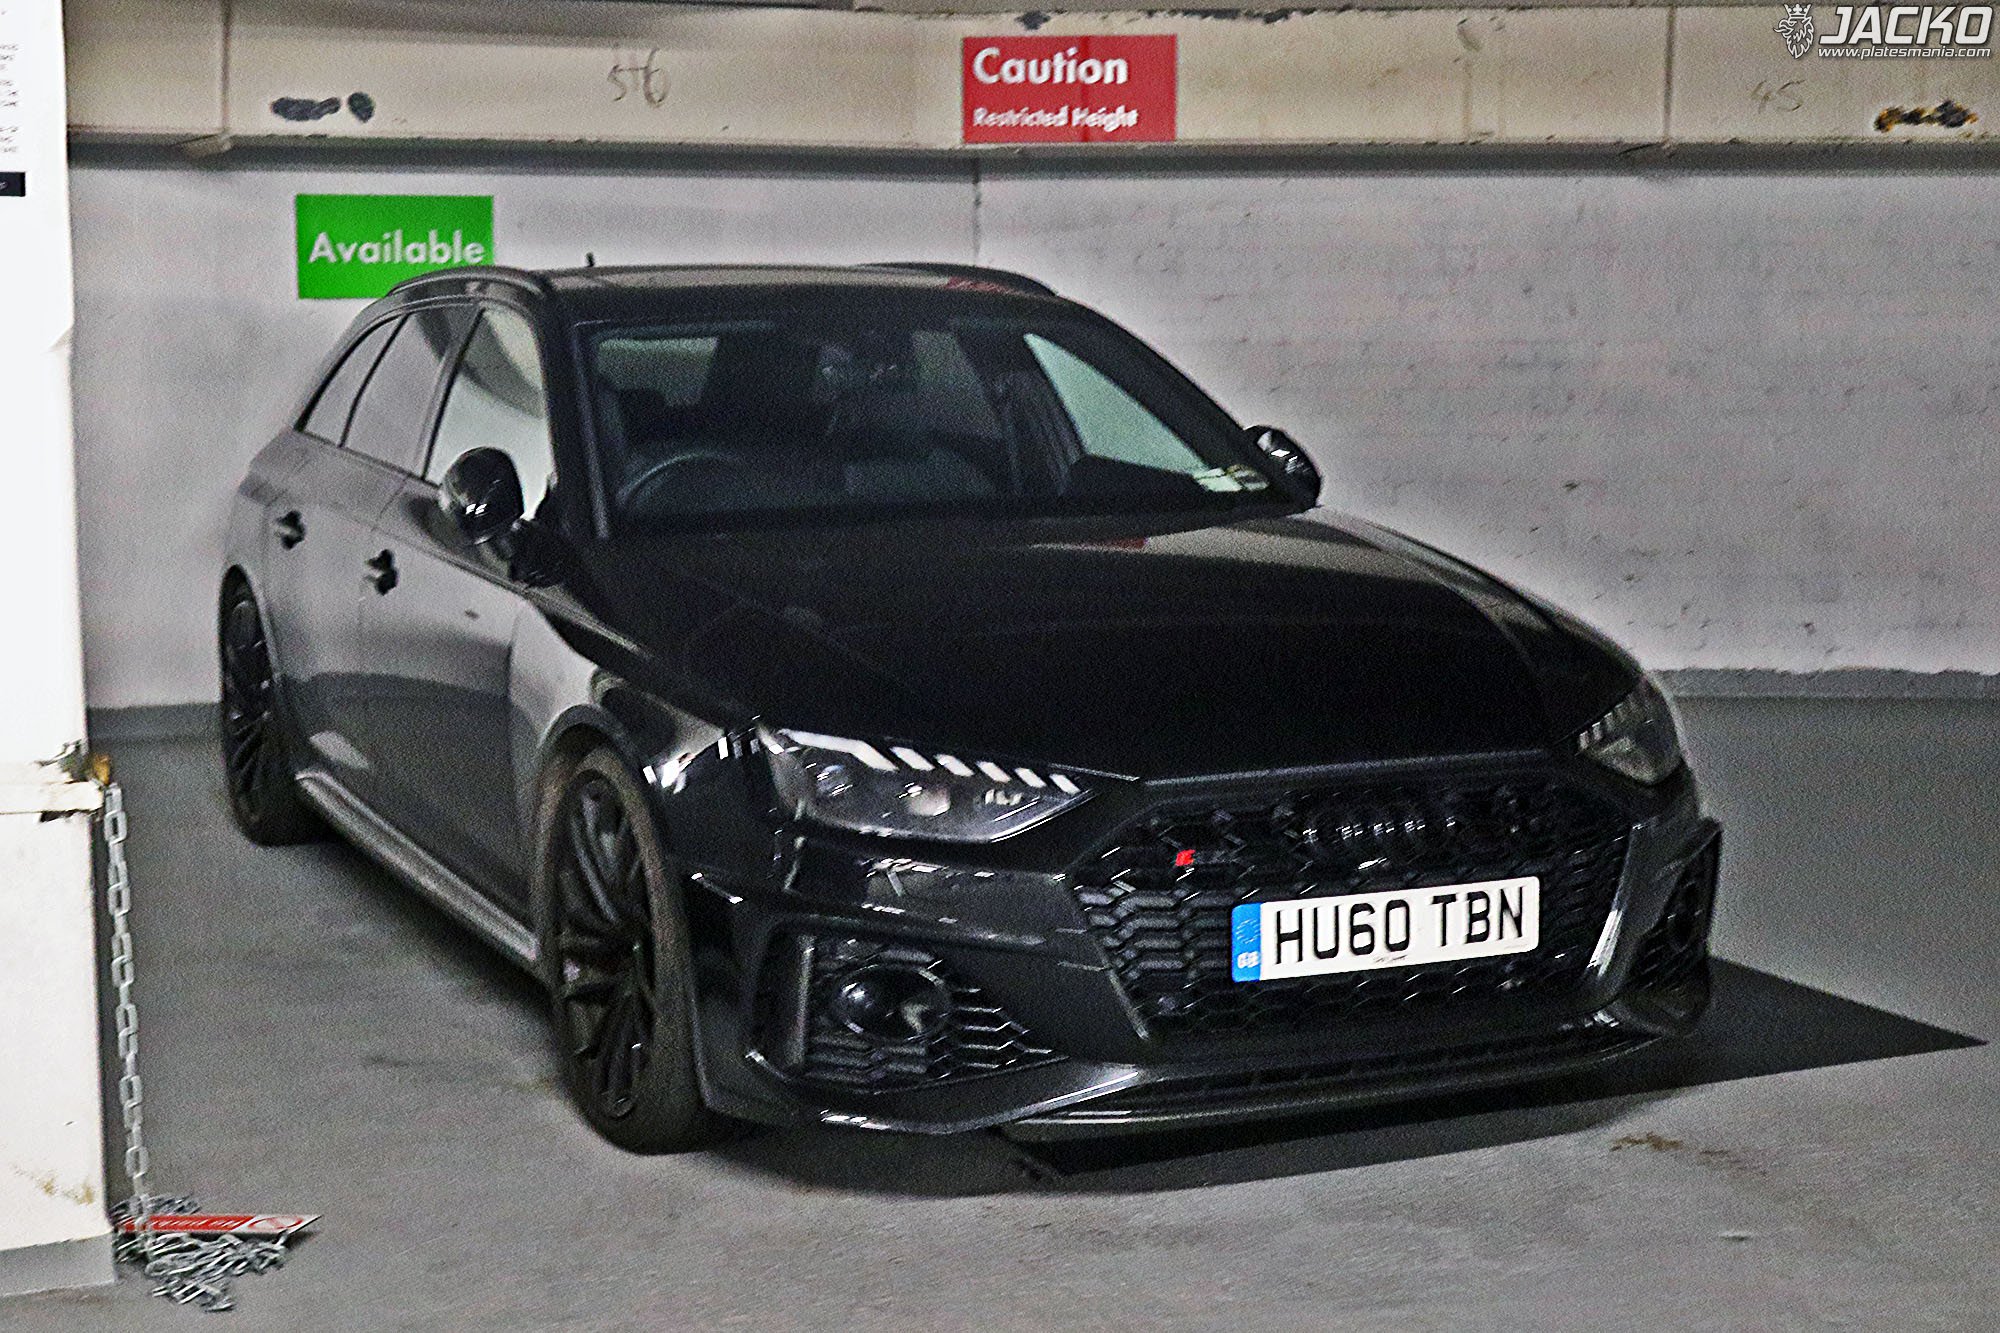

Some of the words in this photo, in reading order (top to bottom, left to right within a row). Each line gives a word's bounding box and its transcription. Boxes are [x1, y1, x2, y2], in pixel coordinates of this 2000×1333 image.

[973, 46, 1128, 84] Caution
[973, 105, 1069, 127] Restricted
[1071, 105, 1138, 132] Height
[308, 229, 485, 264] Available
[1276, 899, 1410, 964] HU60
[1431, 886, 1526, 947] TBN
